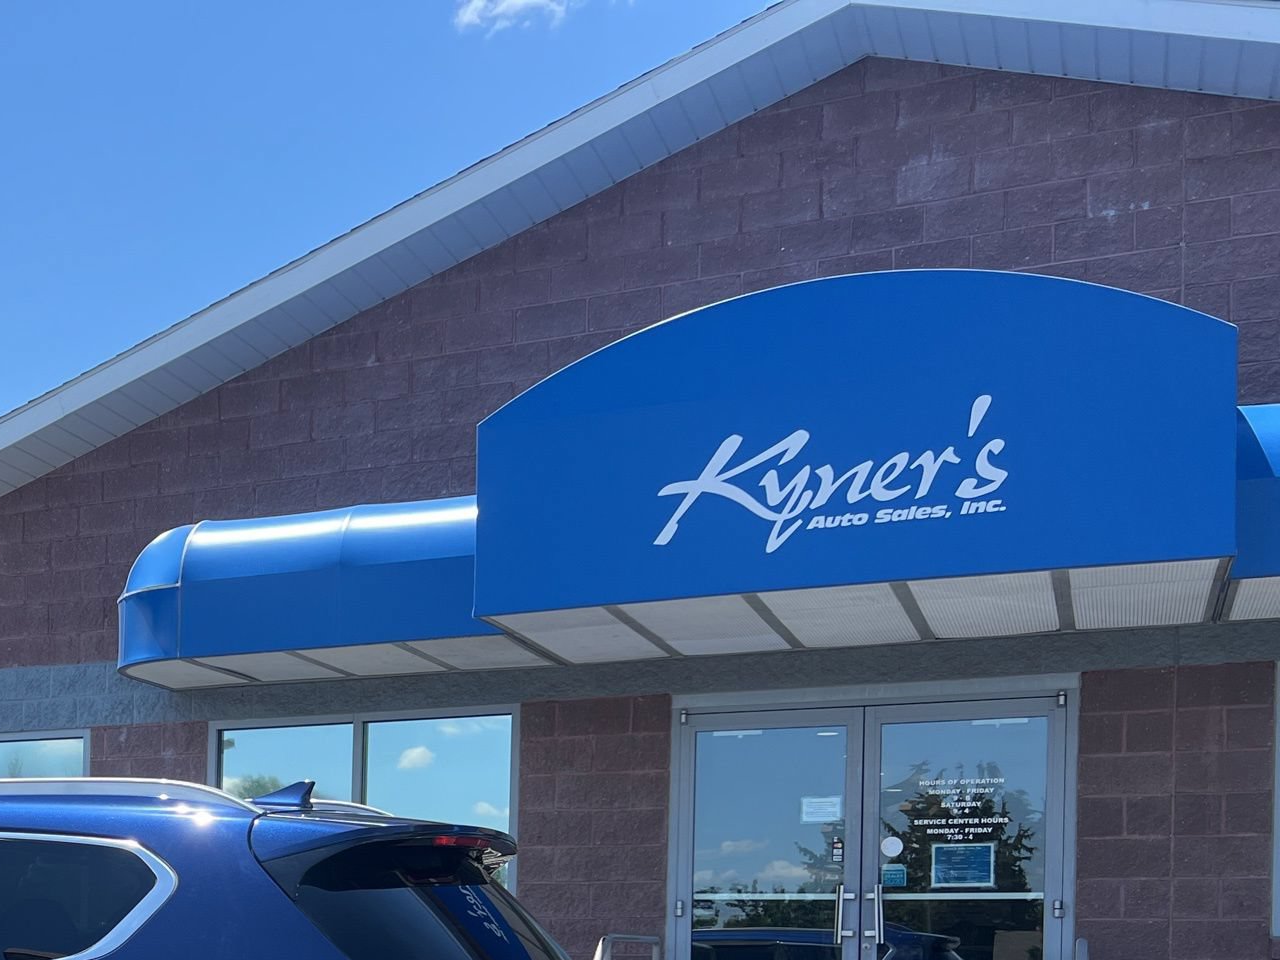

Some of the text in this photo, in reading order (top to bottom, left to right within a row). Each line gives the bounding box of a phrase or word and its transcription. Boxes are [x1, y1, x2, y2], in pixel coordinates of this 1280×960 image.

[652, 394, 1009, 553] Kyner's
[806, 498, 1008, 531] Auto Sales, Inc.
[959, 777, 1005, 785] OPERATION
